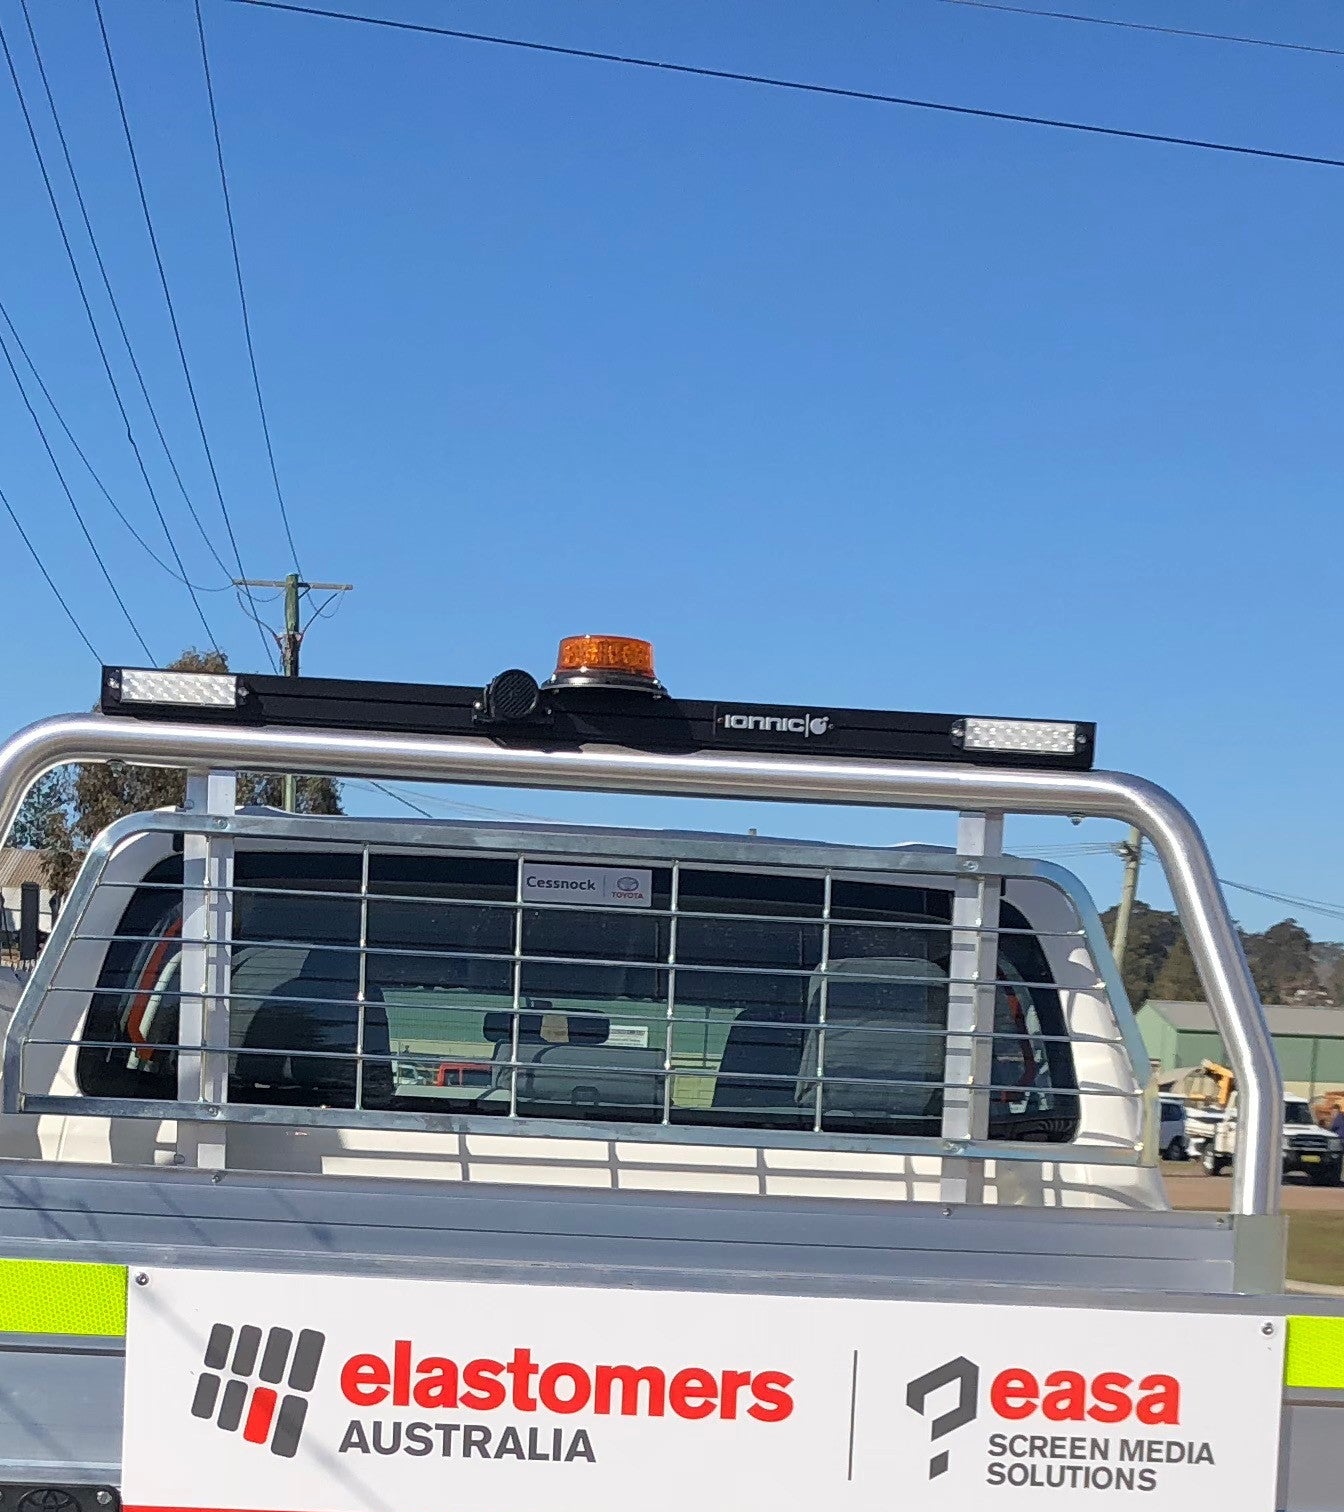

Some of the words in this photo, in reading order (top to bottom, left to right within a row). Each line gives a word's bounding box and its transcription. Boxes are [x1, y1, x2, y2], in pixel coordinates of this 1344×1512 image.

[526, 876, 596, 891] Cessnock
[611, 891, 644, 899] TOYOTA
[340, 1340, 795, 1422] elastomers
[989, 1367, 1181, 1426] easa
[338, 1419, 596, 1463] AUSTRALIA
[987, 1433, 1110, 1462] SCREEN
[1119, 1438, 1216, 1466] MEDIA
[986, 1462, 1157, 1491] SOLUTIONS
